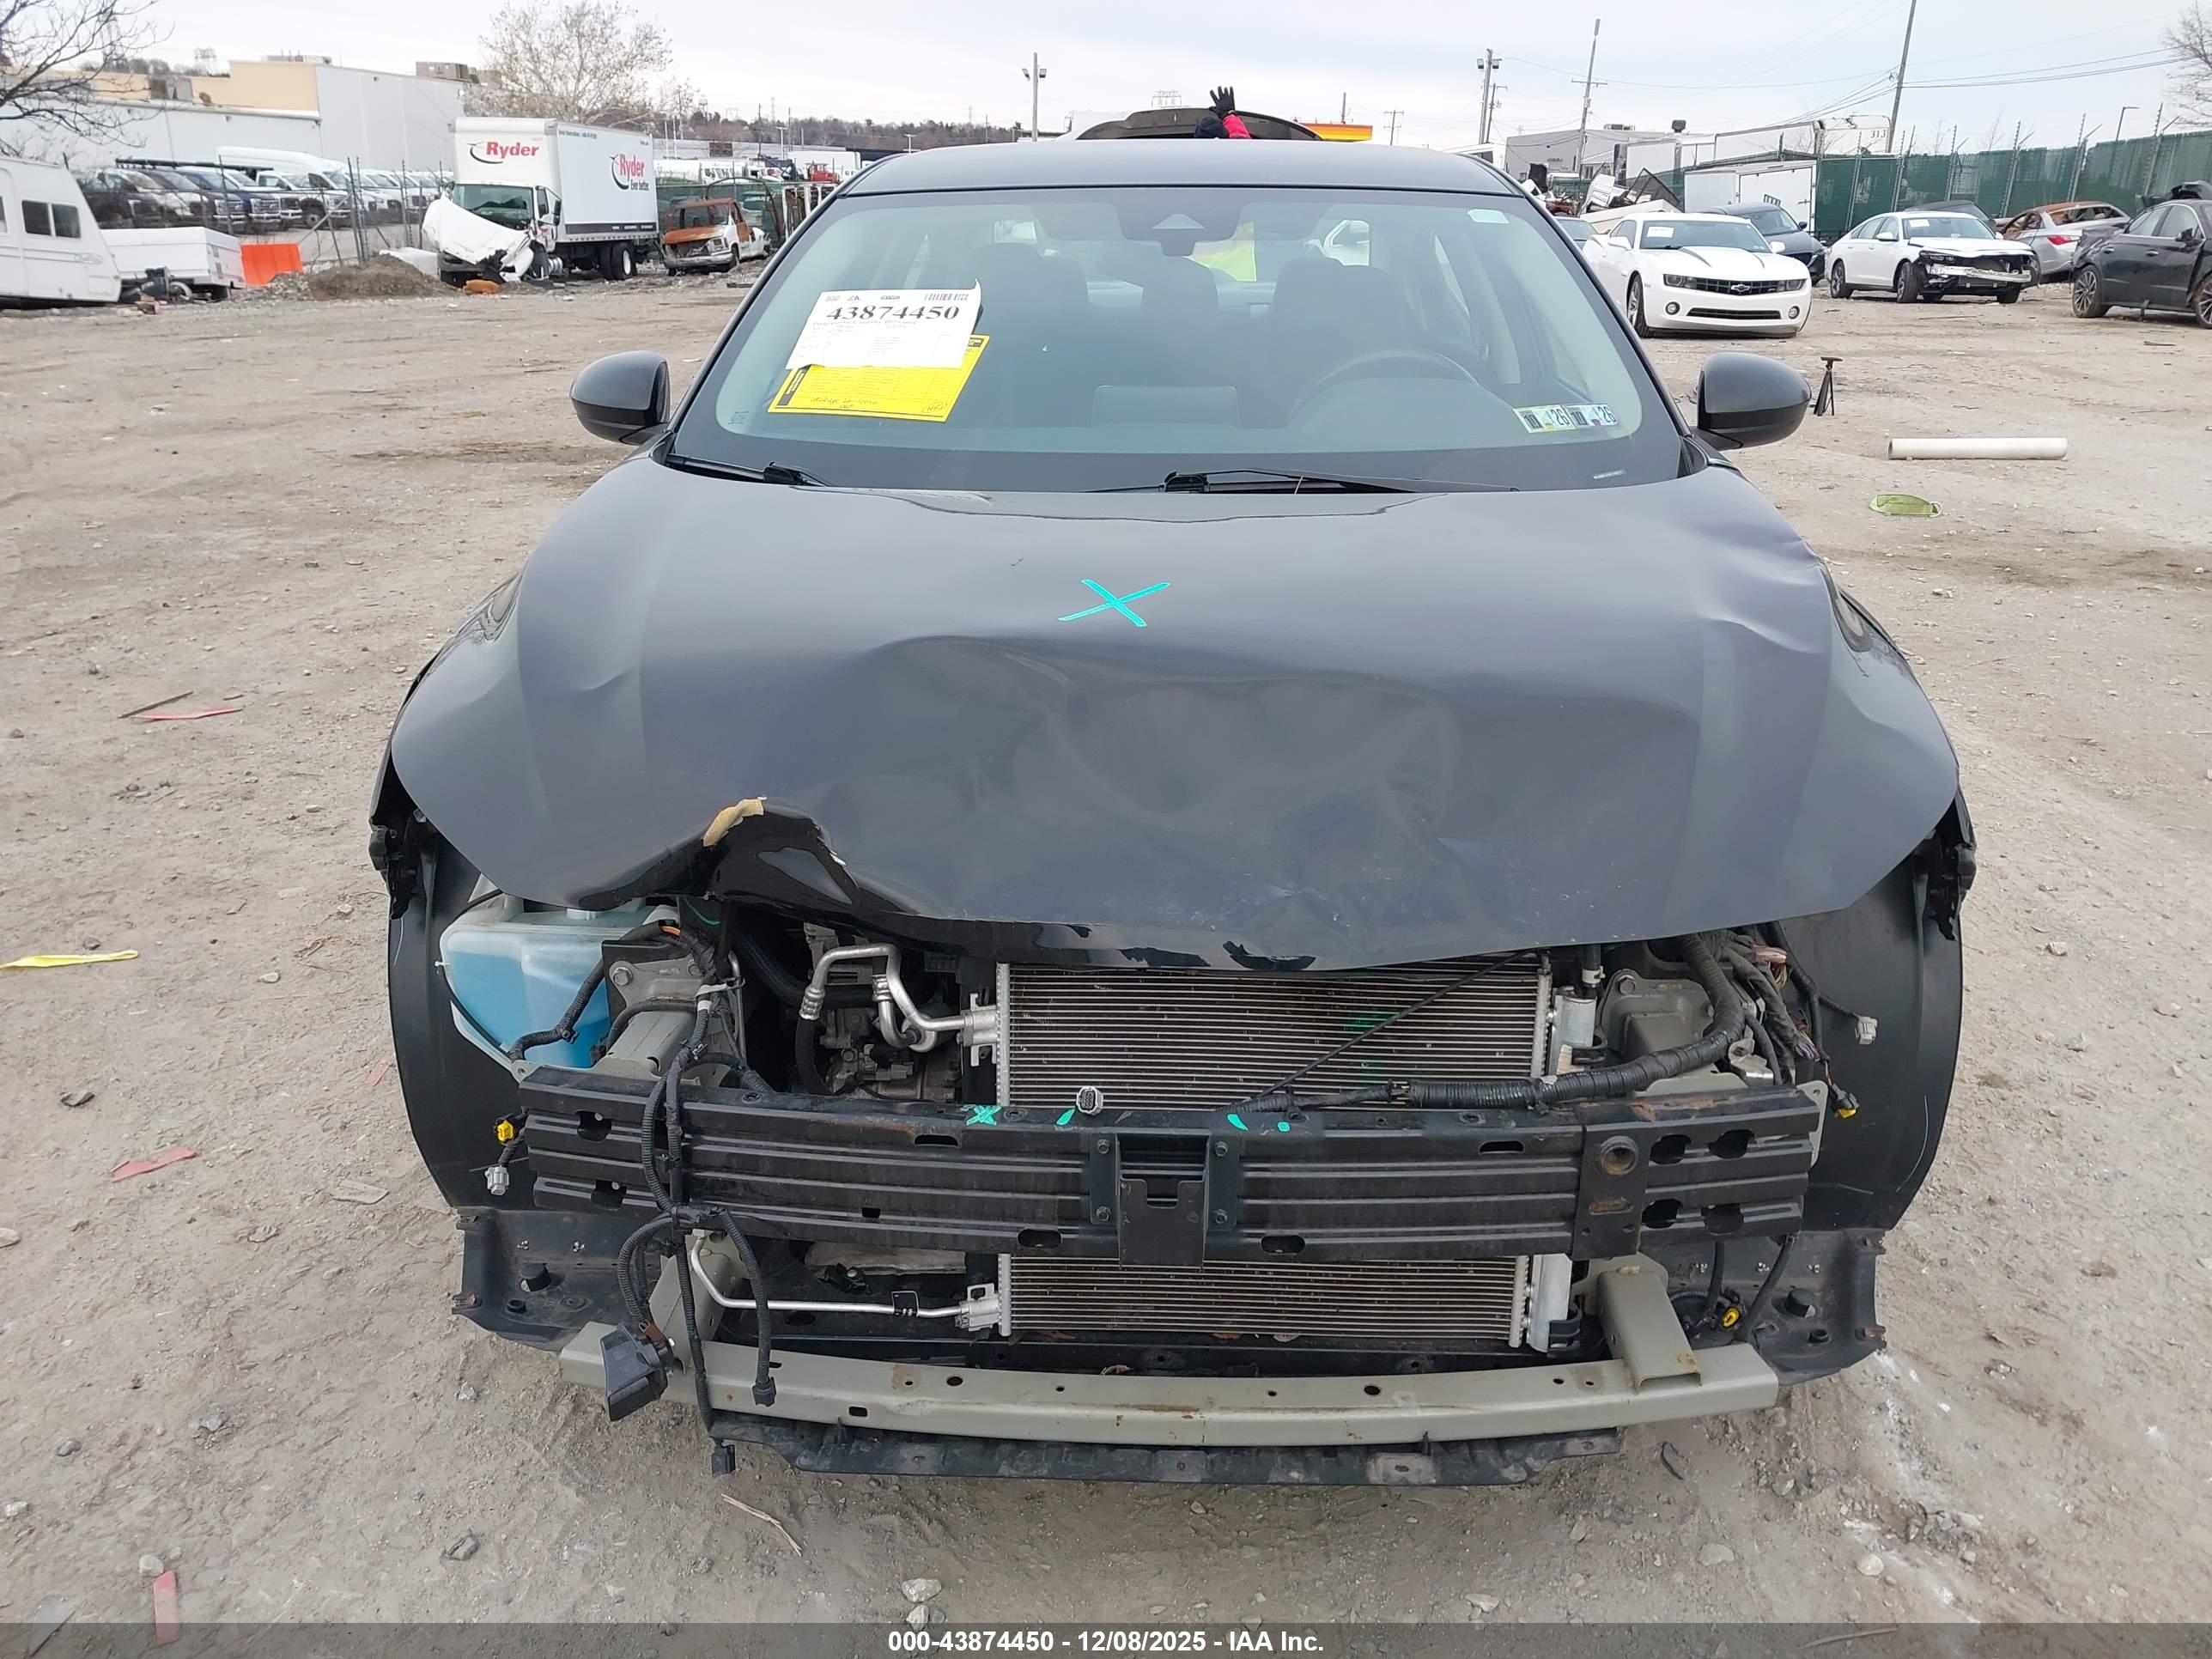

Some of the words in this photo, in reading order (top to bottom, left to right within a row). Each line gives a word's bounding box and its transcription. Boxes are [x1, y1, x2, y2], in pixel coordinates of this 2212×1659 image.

[1870, 130, 1886, 138] 313
[486, 142, 539, 159] Ryder
[619, 154, 645, 181] Ryder
[827, 306, 960, 320] 43874450
[1551, 408, 1571, 426] 26
[1598, 405, 1617, 423] 26
